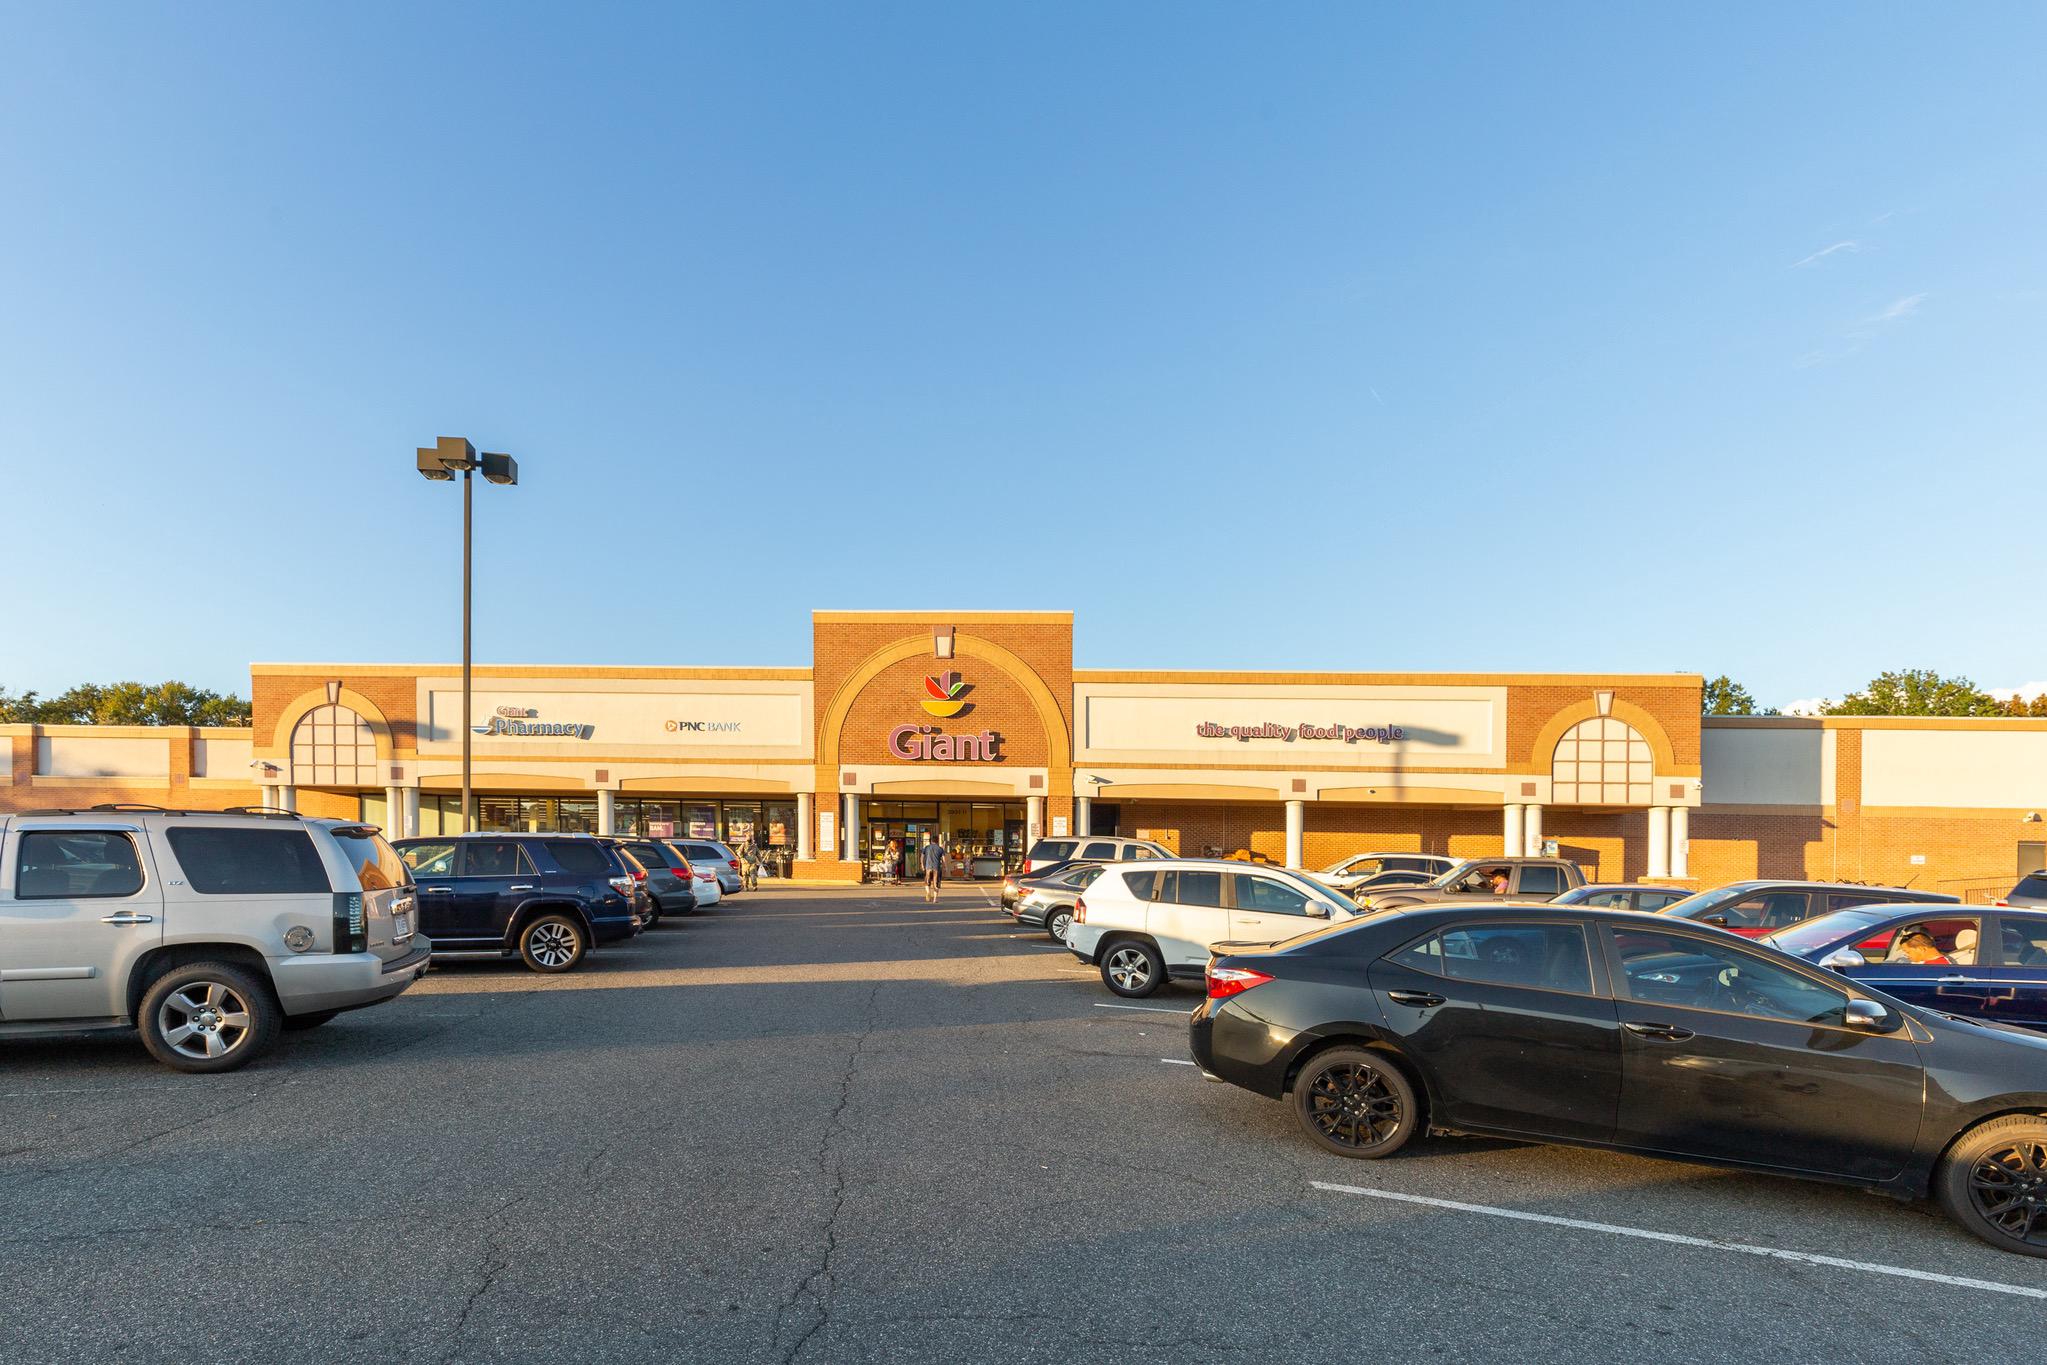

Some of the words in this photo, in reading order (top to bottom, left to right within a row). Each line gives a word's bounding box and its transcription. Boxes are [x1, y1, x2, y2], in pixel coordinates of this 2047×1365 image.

[495, 718, 582, 738] Pharmacy
[679, 721, 706, 732] PNC
[708, 721, 741, 732] BANK
[1196, 721, 1225, 737] the
[1230, 722, 1291, 740] quality
[1299, 723, 1340, 739] food
[1344, 723, 1404, 741] people
[888, 723, 997, 761] Giant
